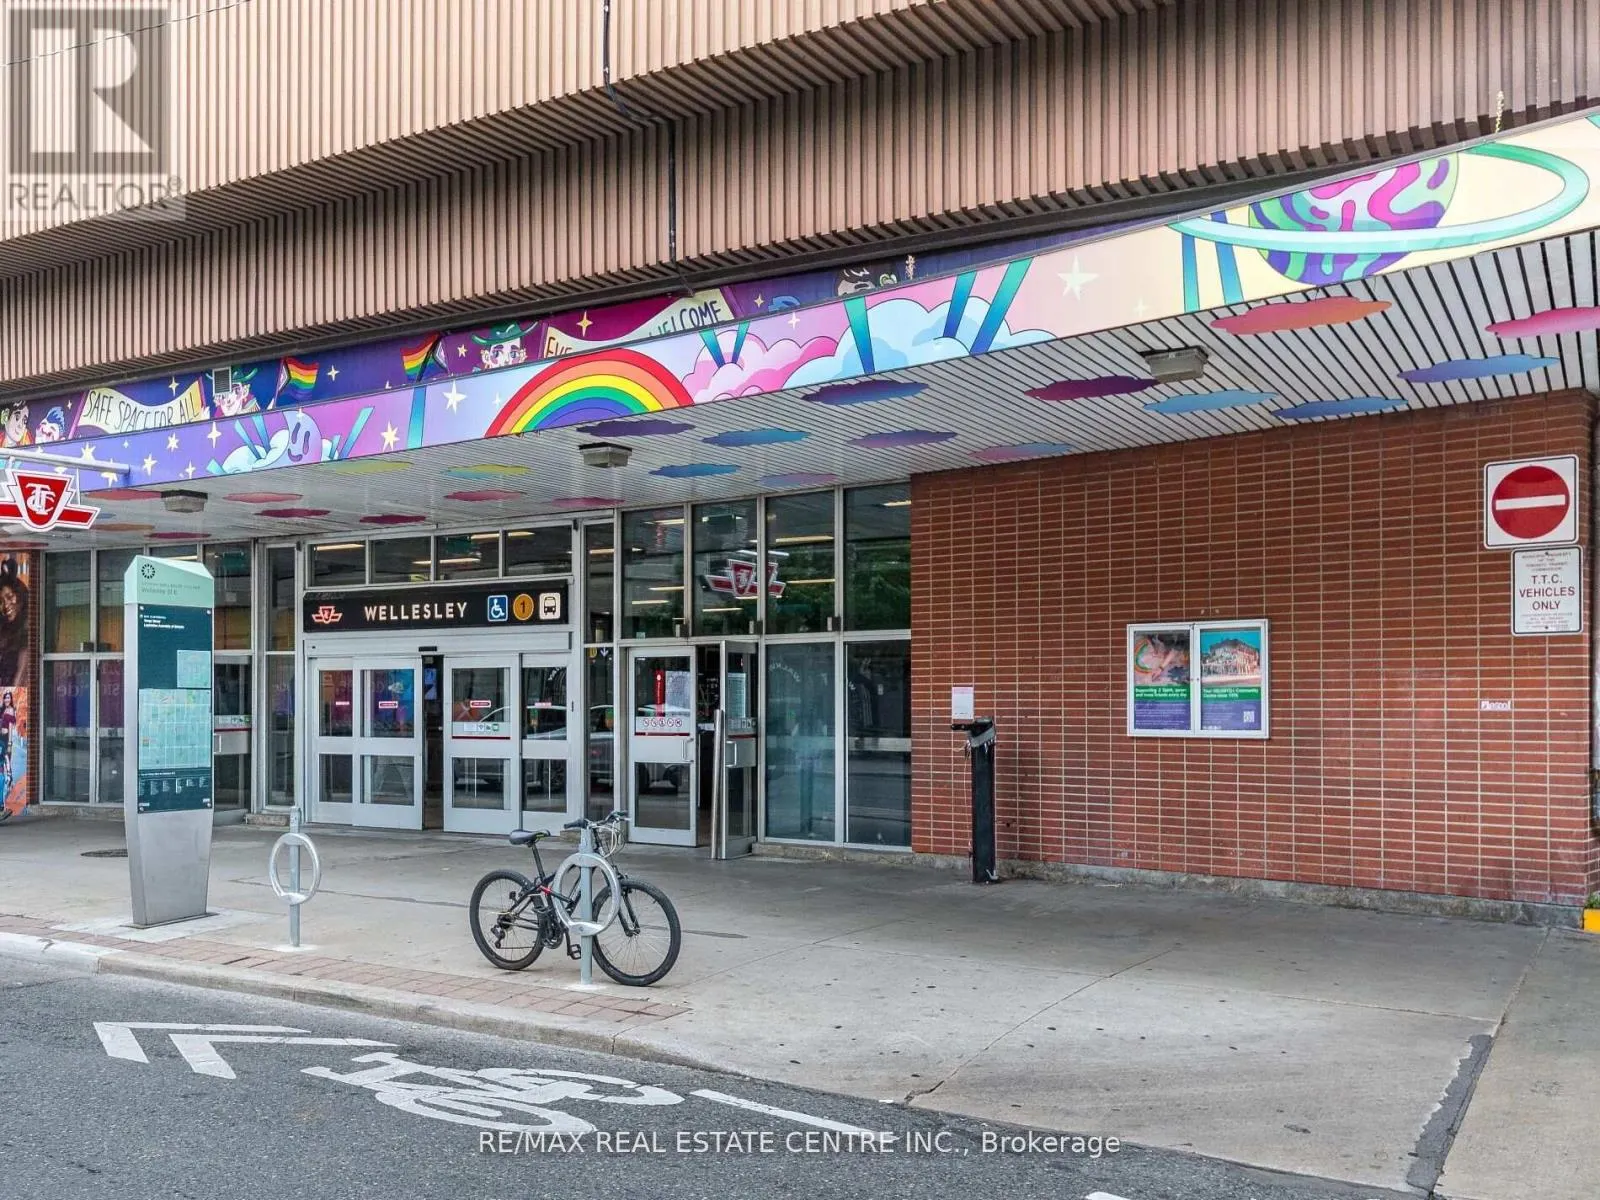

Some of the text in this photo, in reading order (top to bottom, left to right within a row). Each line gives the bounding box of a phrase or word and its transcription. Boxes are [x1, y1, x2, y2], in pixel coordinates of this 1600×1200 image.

[83, 391, 113, 425] SAFE
[180, 392, 200, 425] ALL
[1531, 574, 1563, 585] T.T.C.
[1519, 586, 1575, 598] VEHICLES
[1532, 600, 1561, 611] ONLY
[364, 602, 468, 622] WELLESLEY
